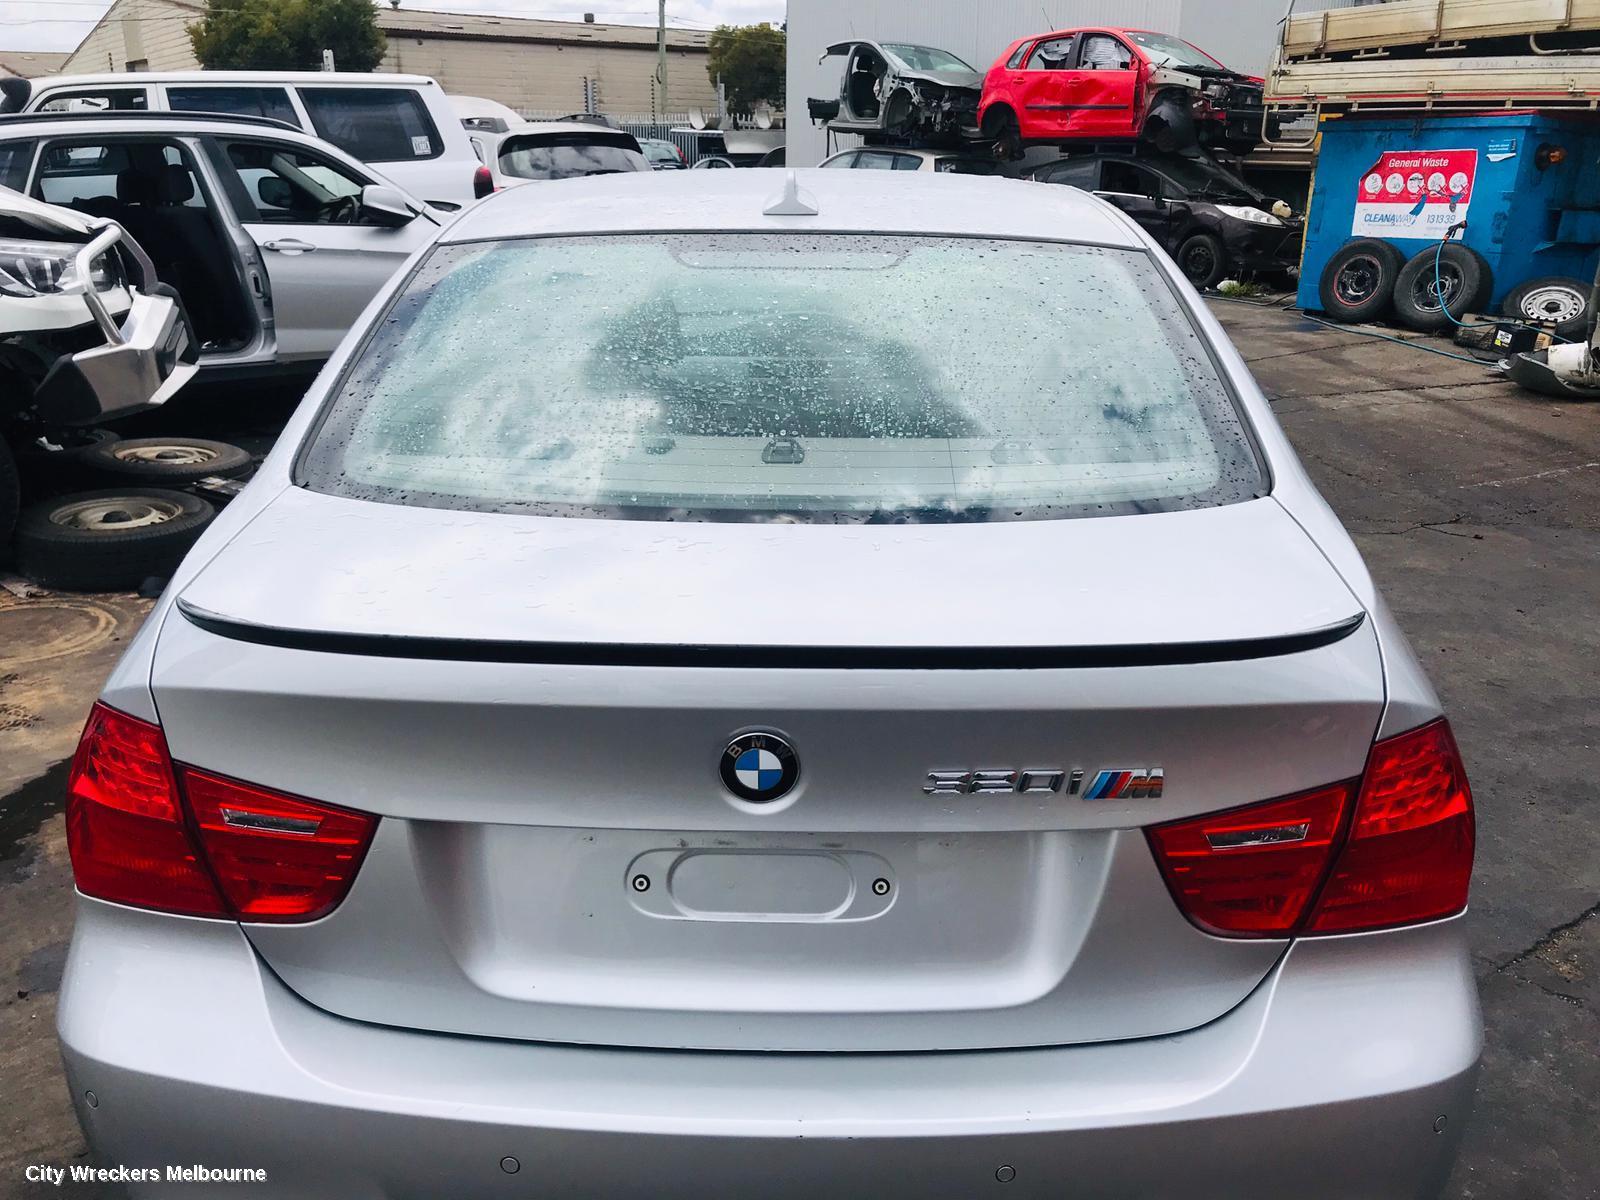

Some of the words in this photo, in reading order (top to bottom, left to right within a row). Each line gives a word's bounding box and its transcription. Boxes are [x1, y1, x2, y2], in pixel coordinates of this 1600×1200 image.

[1389, 158, 1421, 168] General
[1422, 157, 1449, 167] Waste
[727, 735, 792, 760] BMW
[923, 769, 1084, 795] 320i
